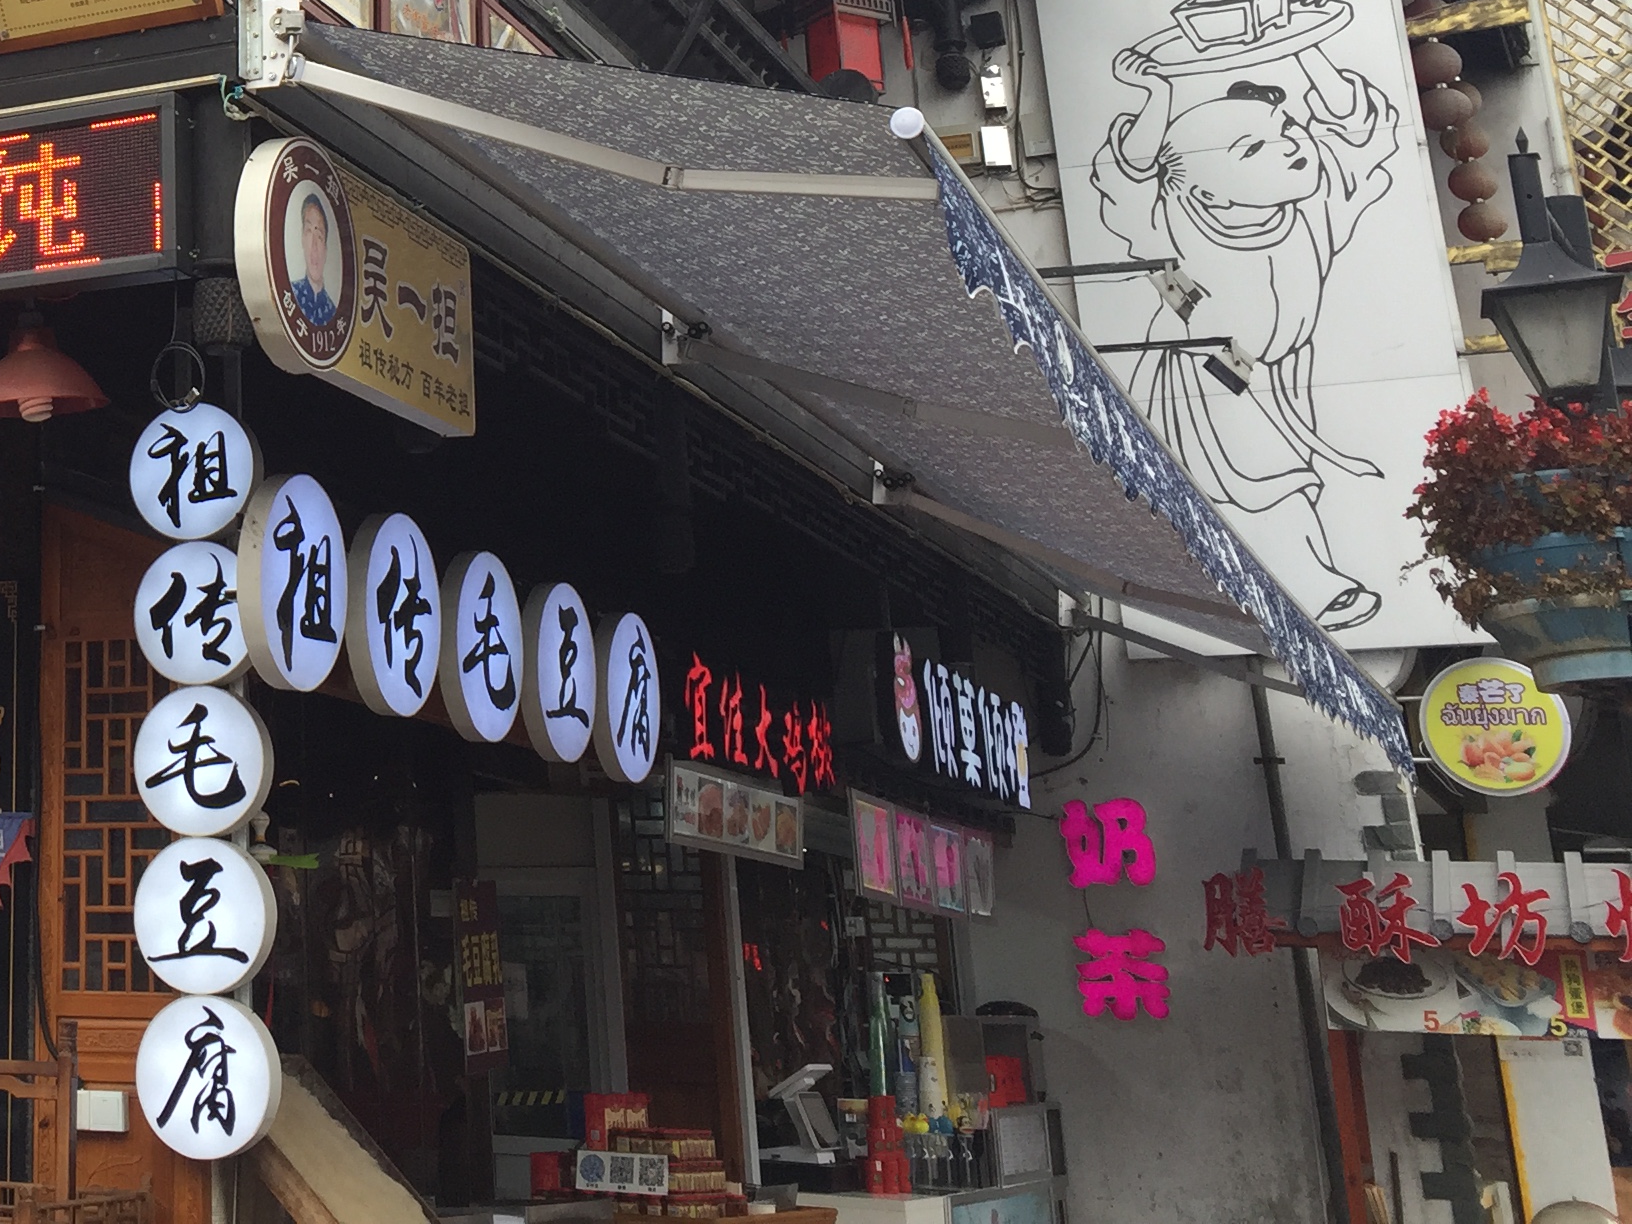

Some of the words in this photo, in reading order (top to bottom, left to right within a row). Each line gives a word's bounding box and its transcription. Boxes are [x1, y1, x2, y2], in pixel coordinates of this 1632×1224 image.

[283, 156, 340, 205] 吴一担
[361, 238, 459, 366] 吴一担
[359, 339, 414, 390] 祖传秘方
[420, 370, 470, 417] 百年老担
[273, 494, 652, 762] 祖传毛豆腐
[146, 423, 250, 1136] 祖传毛豆腐
[1060, 797, 1170, 1021] 奶茶
[1423, 1010, 1440, 1032] 5
